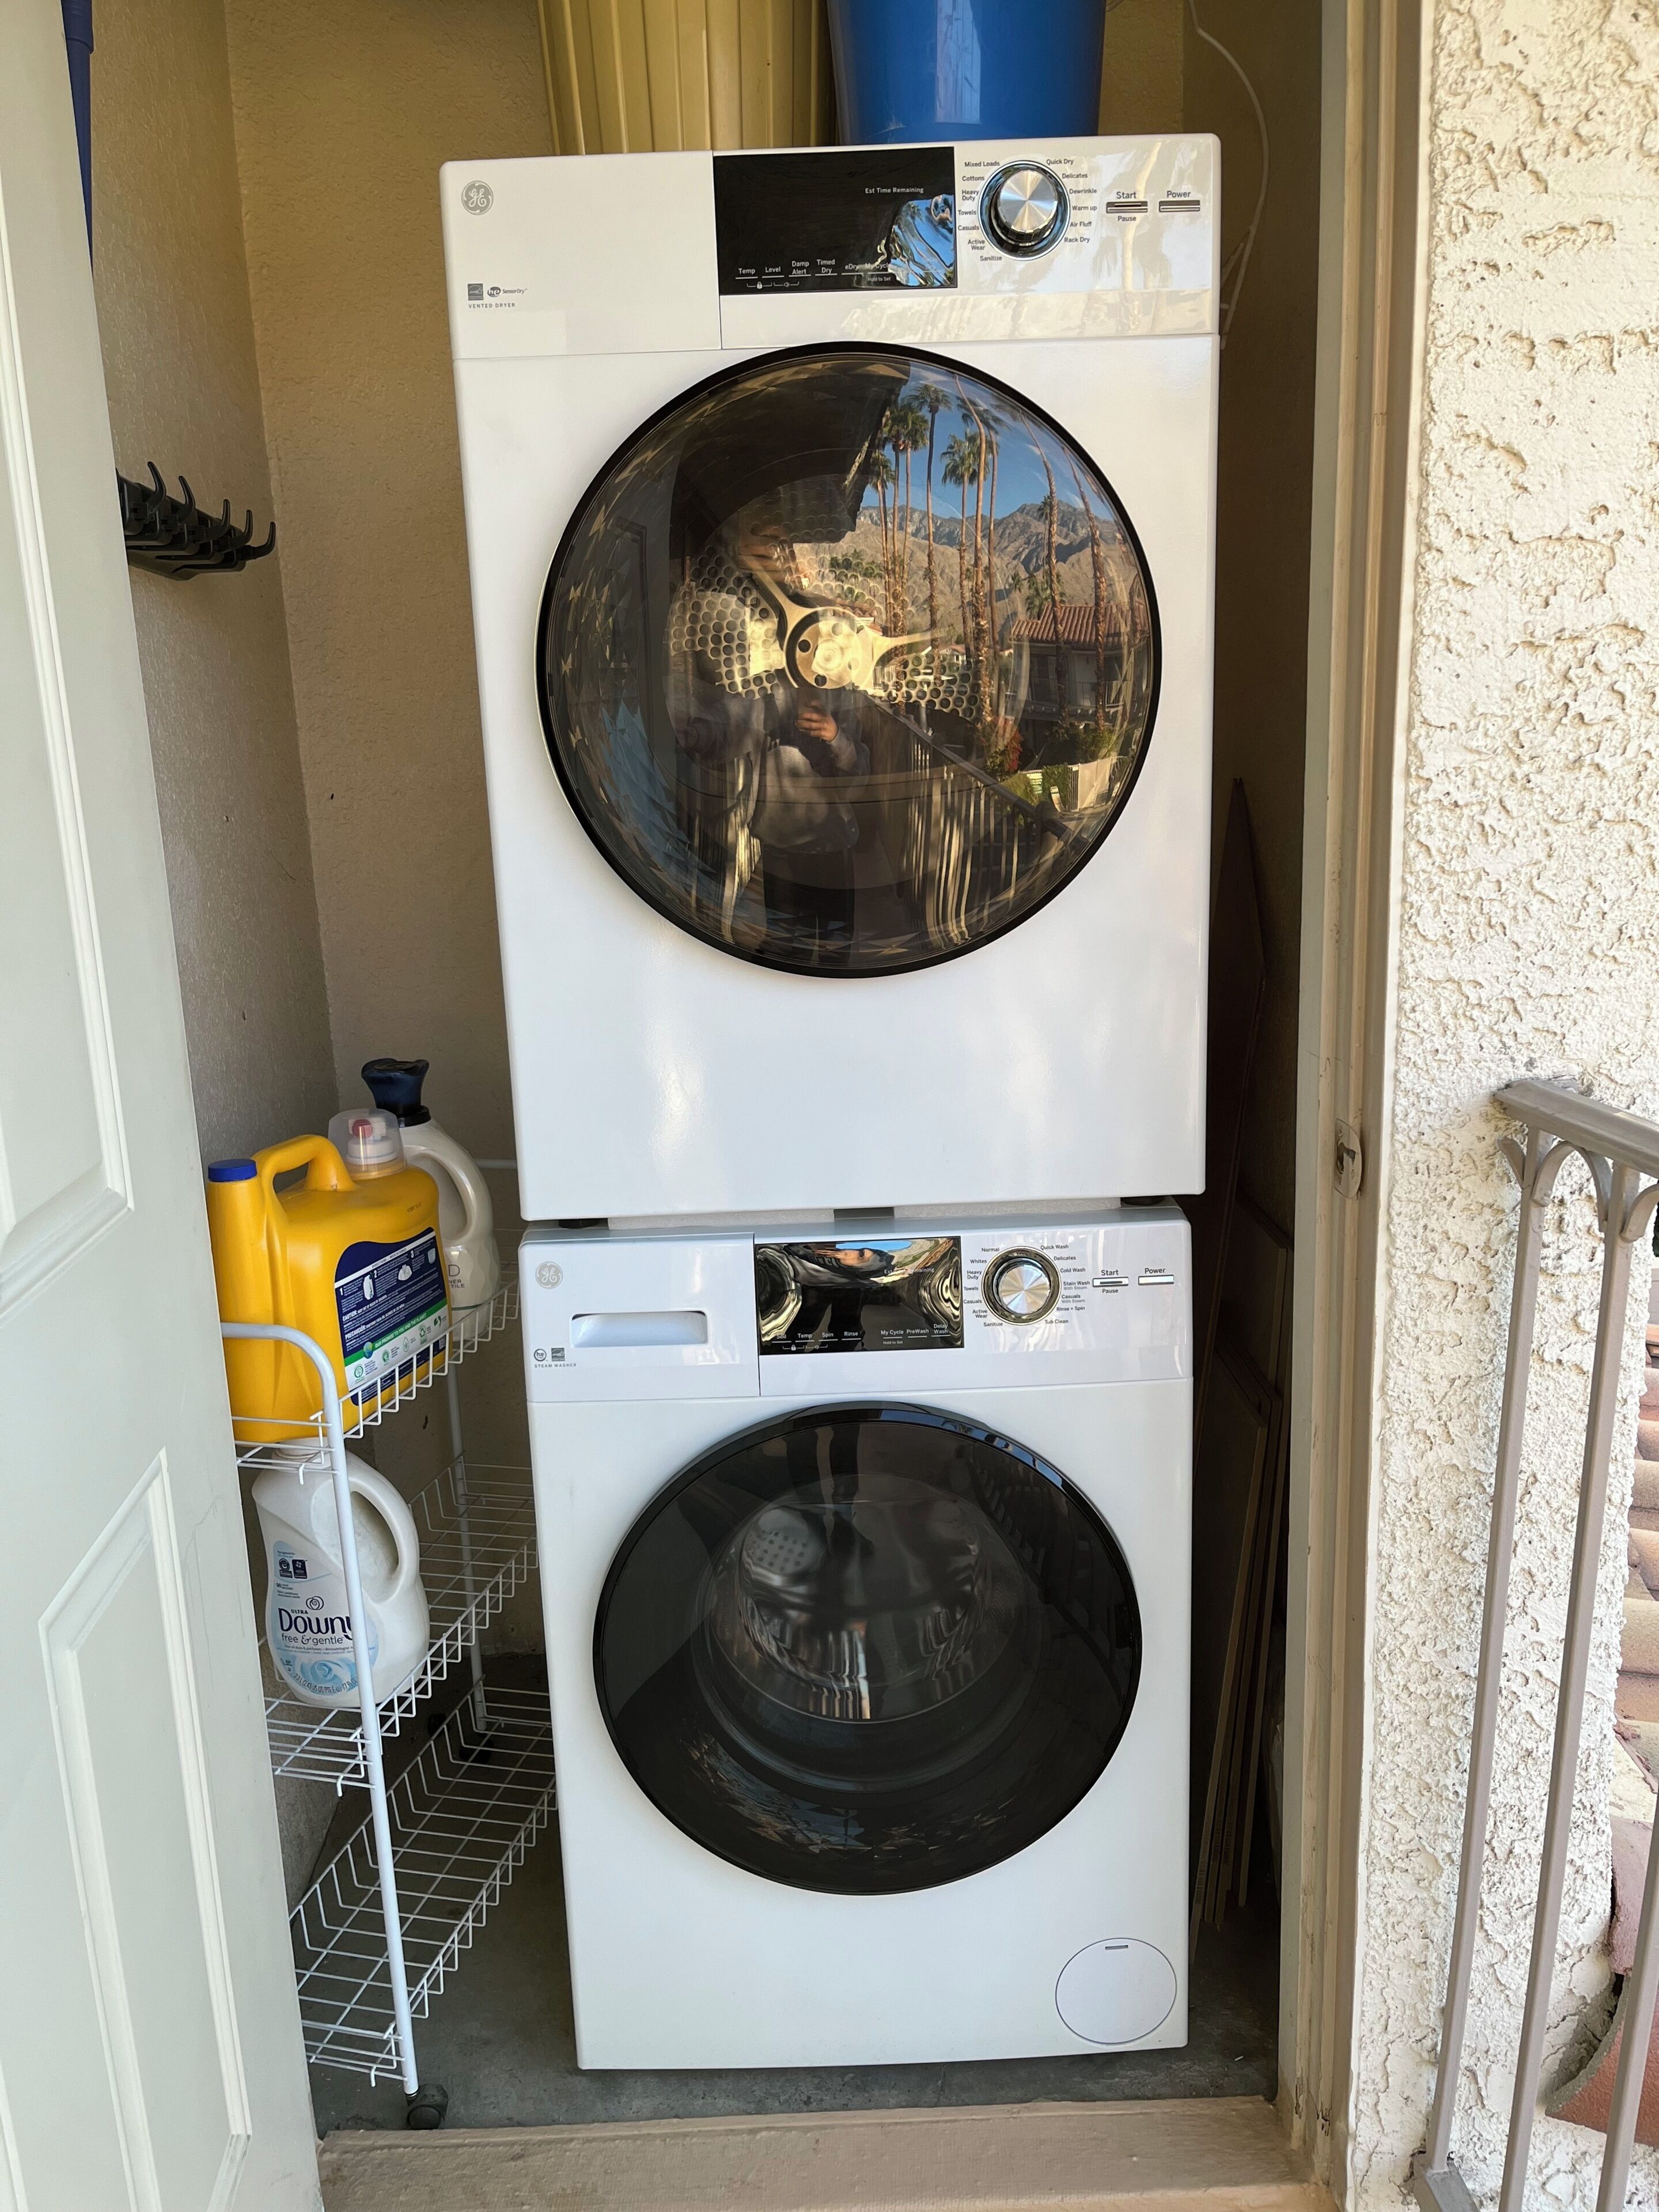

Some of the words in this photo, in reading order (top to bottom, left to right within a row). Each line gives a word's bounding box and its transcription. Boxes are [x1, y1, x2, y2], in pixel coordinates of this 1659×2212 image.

[876, 262, 890, 270] Cycl
[373, 1270, 377, 1278] 2
[339, 1287, 343, 1296] 1
[278, 1607, 353, 1641] Downy
[281, 1633, 298, 1642] free
[301, 1633, 311, 1645] &
